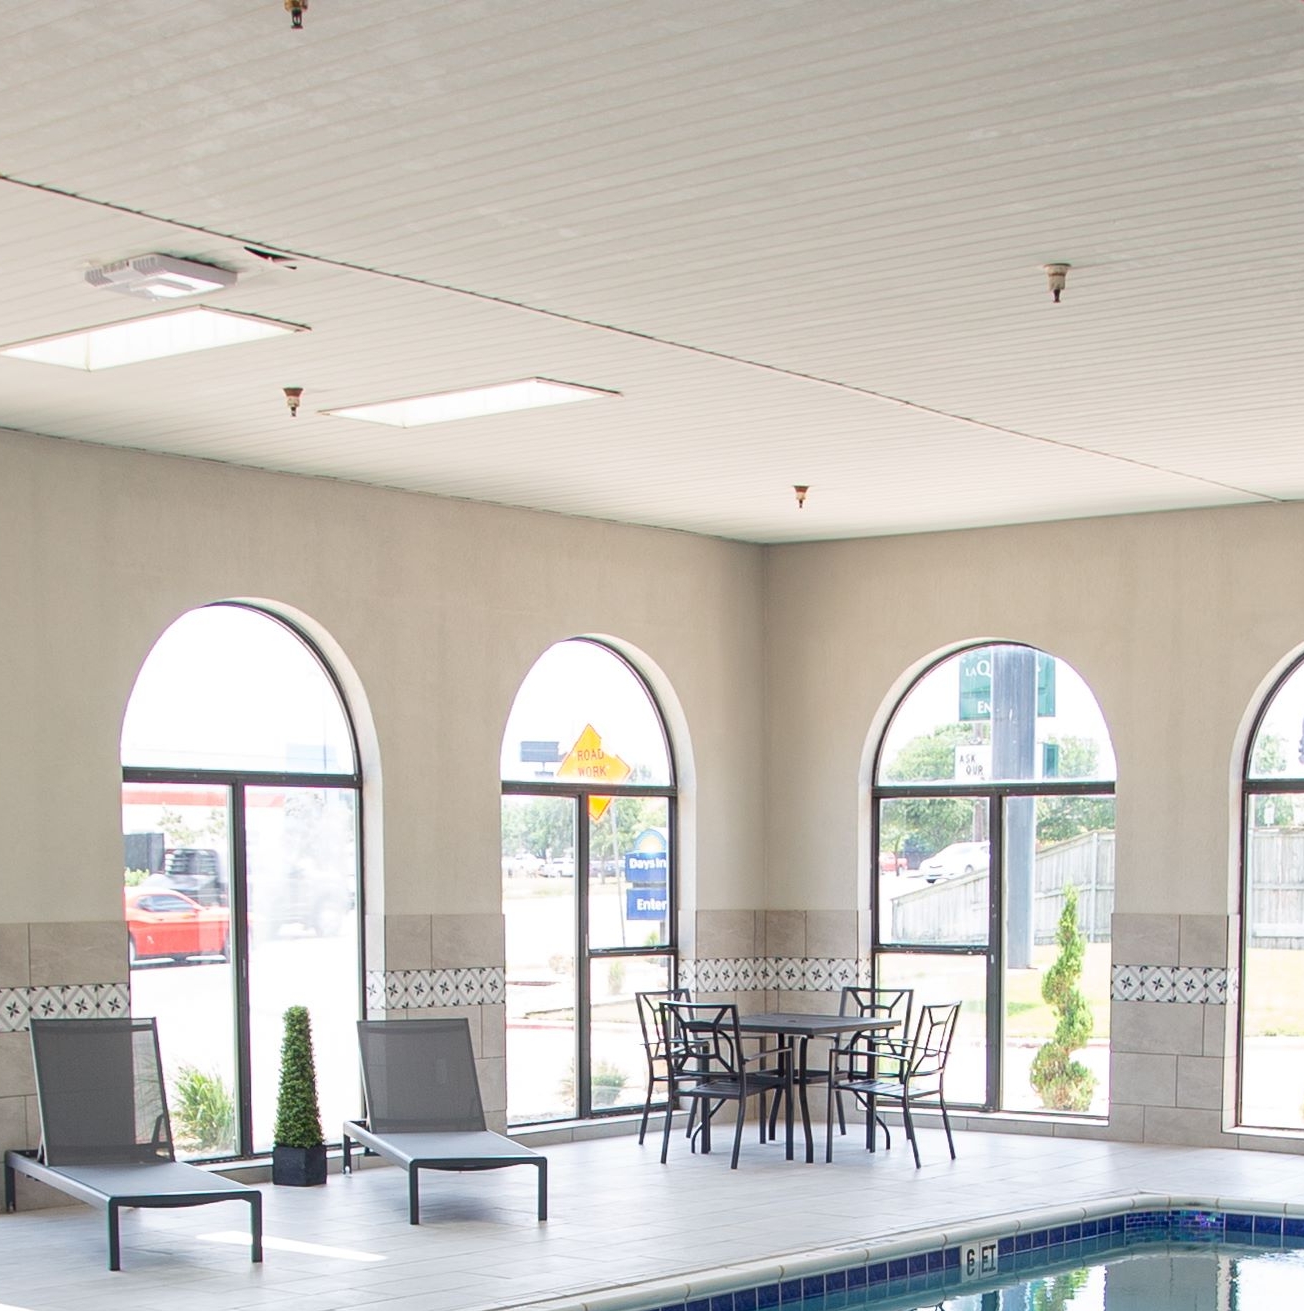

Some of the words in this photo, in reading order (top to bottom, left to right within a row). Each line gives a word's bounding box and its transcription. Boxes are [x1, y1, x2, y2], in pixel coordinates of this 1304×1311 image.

[577, 749, 604, 761] ROAD
[577, 766, 606, 777] WORK
[629, 858, 654, 870] Days
[636, 898, 667, 911] Enter
